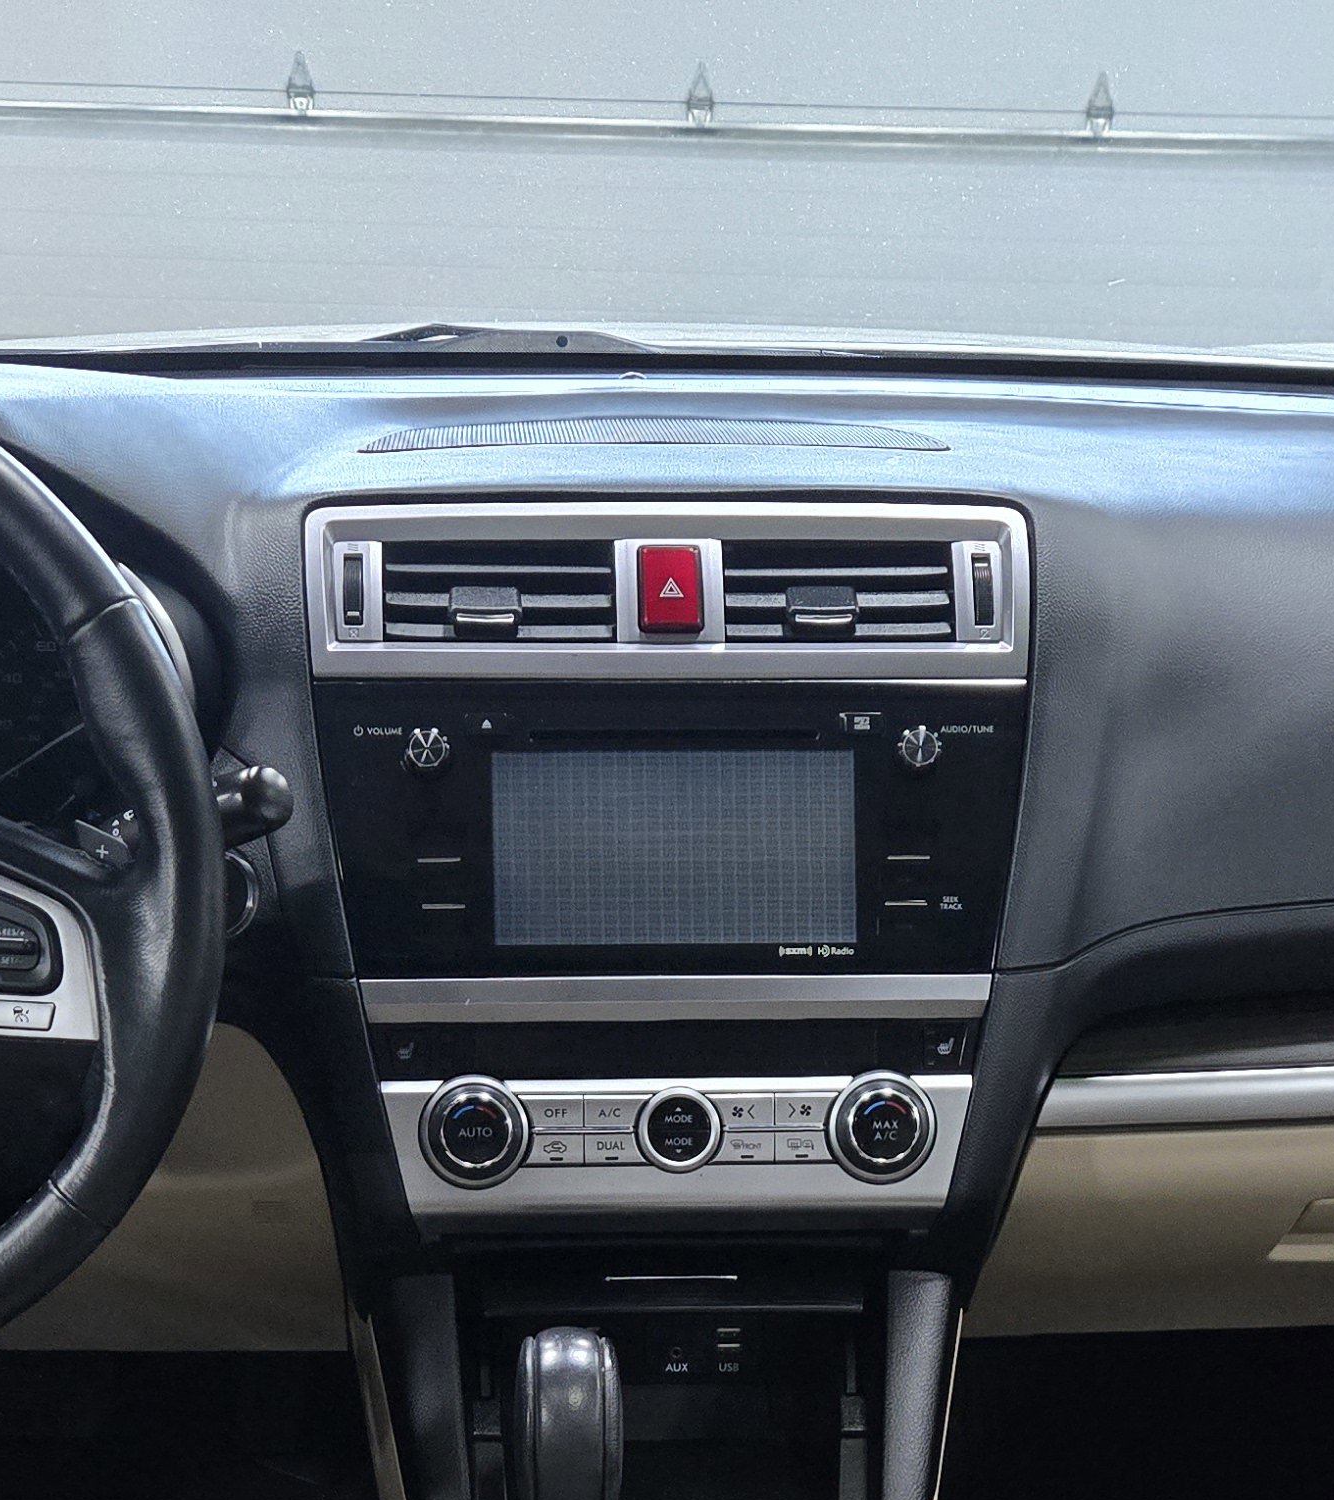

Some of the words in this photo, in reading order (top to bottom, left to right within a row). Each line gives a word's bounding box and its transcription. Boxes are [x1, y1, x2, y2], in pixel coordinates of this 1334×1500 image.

[367, 727, 403, 735] VOLUME
[940, 724, 995, 734] AUDIO/TUNE
[544, 1109, 567, 1118] OFF
[598, 1108, 621, 1118] A/C
[664, 1114, 693, 1124] MODE
[872, 1121, 899, 1130] MAX
[458, 1127, 493, 1138] AUTO
[874, 1131, 897, 1141] A/C
[596, 1141, 625, 1150] DUAL
[665, 1137, 693, 1147] MODE
[742, 1142, 762, 1150] FRONT
[665, 1362, 688, 1372] AUX
[718, 1362, 740, 1372] USB
